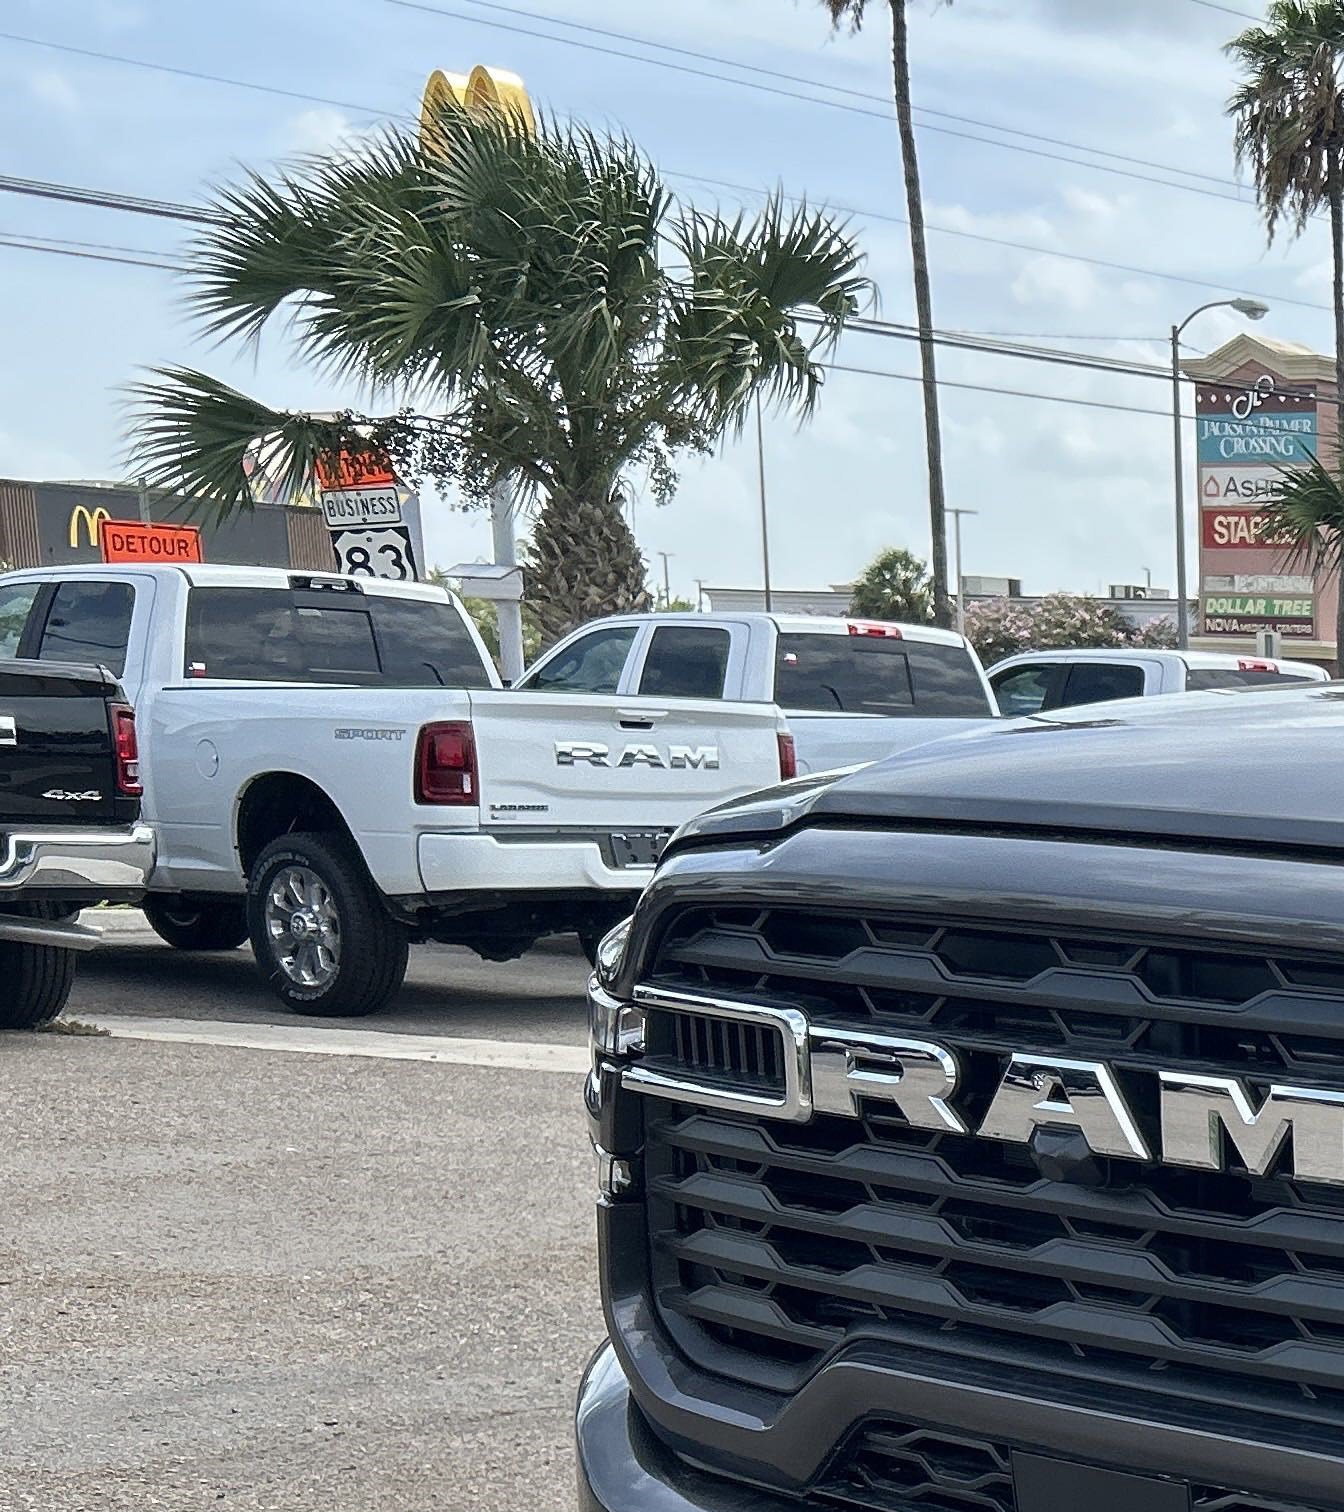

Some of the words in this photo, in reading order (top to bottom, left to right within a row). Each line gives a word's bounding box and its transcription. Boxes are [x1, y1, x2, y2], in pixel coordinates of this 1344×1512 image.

[1201, 418, 1258, 439] JACKSON
[1259, 417, 1312, 436] PALMER
[1220, 436, 1294, 458] CROSSING
[327, 496, 396, 517] BUSINESS
[111, 532, 190, 557] DETOUR
[346, 544, 407, 581] 83
[1206, 598, 1267, 615] DOLLAR
[1273, 600, 1313, 616] TREE
[1205, 619, 1240, 632] NOVA
[334, 728, 407, 741] SPORT
[554, 741, 720, 770] RAM
